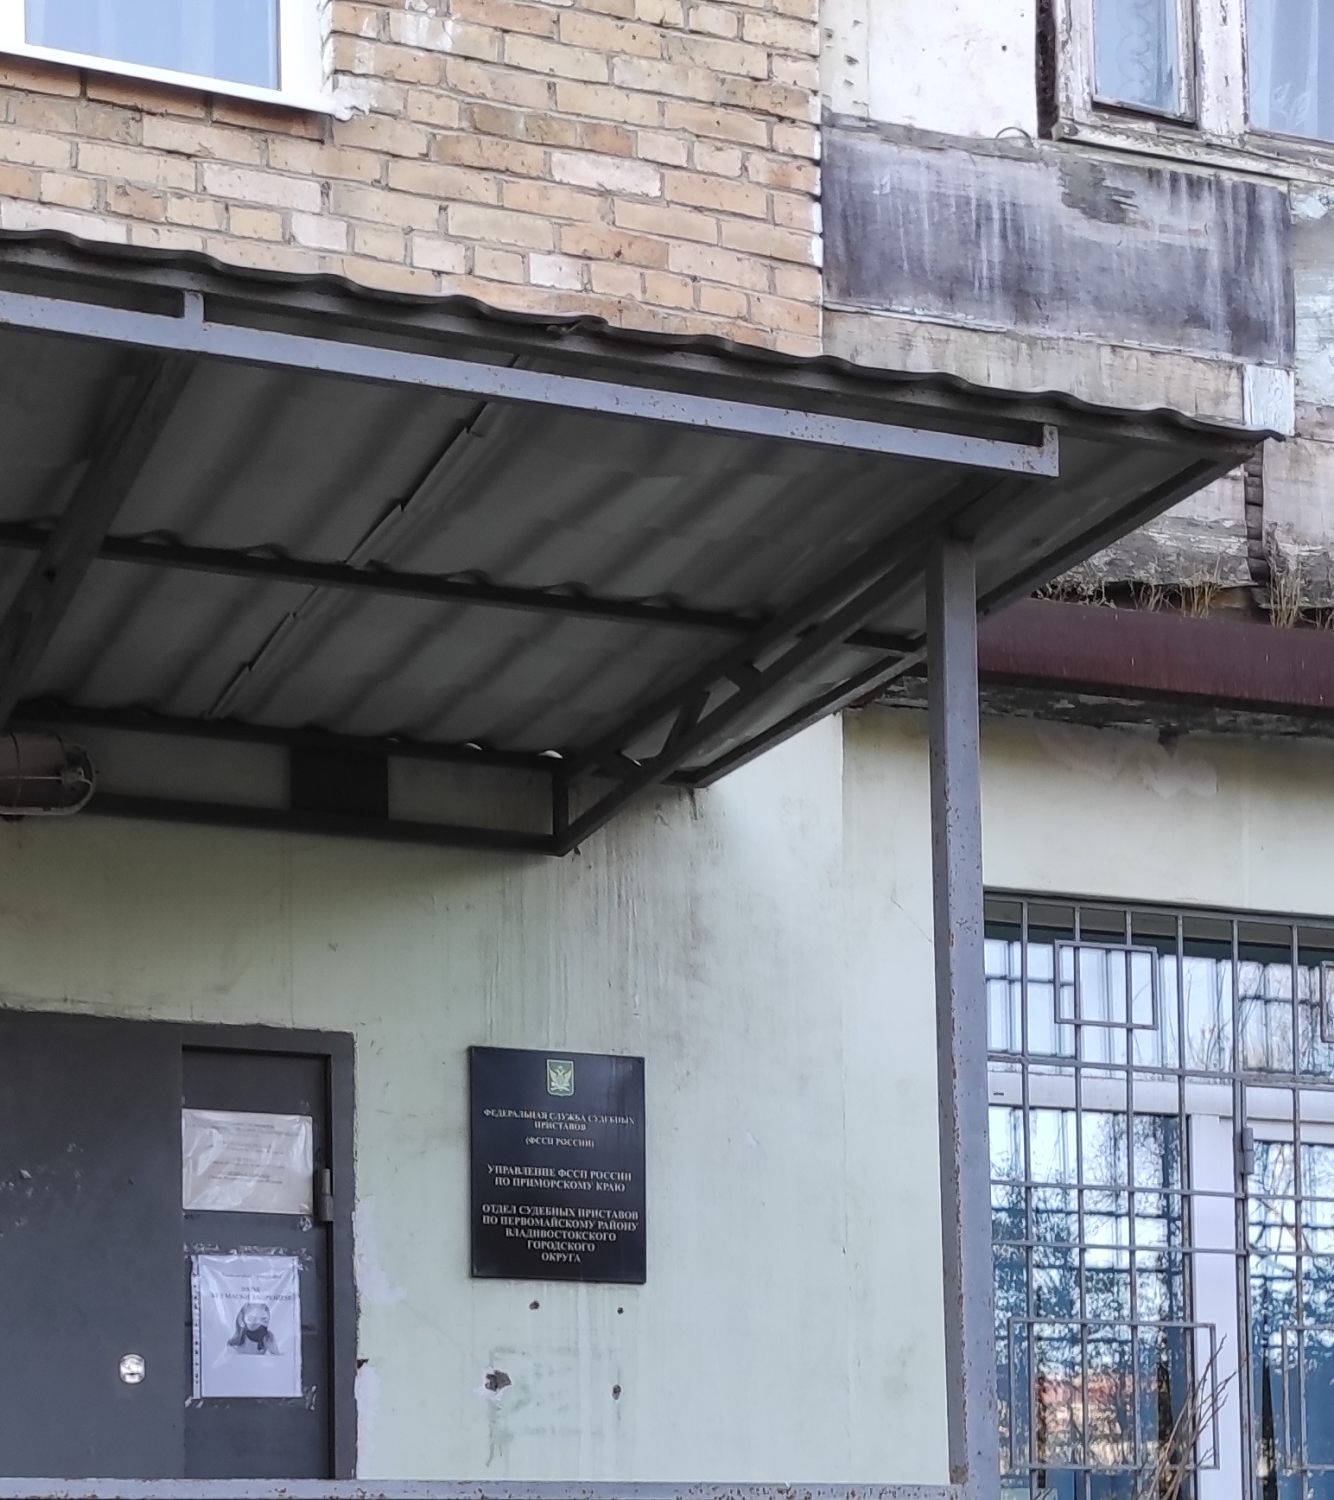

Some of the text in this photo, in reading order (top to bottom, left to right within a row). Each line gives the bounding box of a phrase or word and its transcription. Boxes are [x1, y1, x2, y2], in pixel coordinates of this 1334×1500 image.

[483, 1109, 635, 1125] ФЕДЕРАЛЬНАЯ СЛУЖБА СУДЕБНЫХ
[534, 1122, 586, 1131] ПРИСТАВОВ
[487, 1164, 632, 1182] УПРАВЛЕНИЕ ФССП РОССИИ
[495, 1176, 625, 1192] ПО ПРИМОРСКОМУ КРАЮ
[482, 1203, 639, 1220] ОТДЕЛ СУДЕБНЫХ ПРИСТАВОВ
[482, 1215, 638, 1232] ПО ПЕРВОМАЙСКОМУ РАЙОНУ
[505, 1227, 616, 1242] ВЛАДИВОСТОКСКОГО
[527, 1240, 595, 1252] ГОРОДСКОГО
[541, 1252, 581, 1263] ОКРУГА
